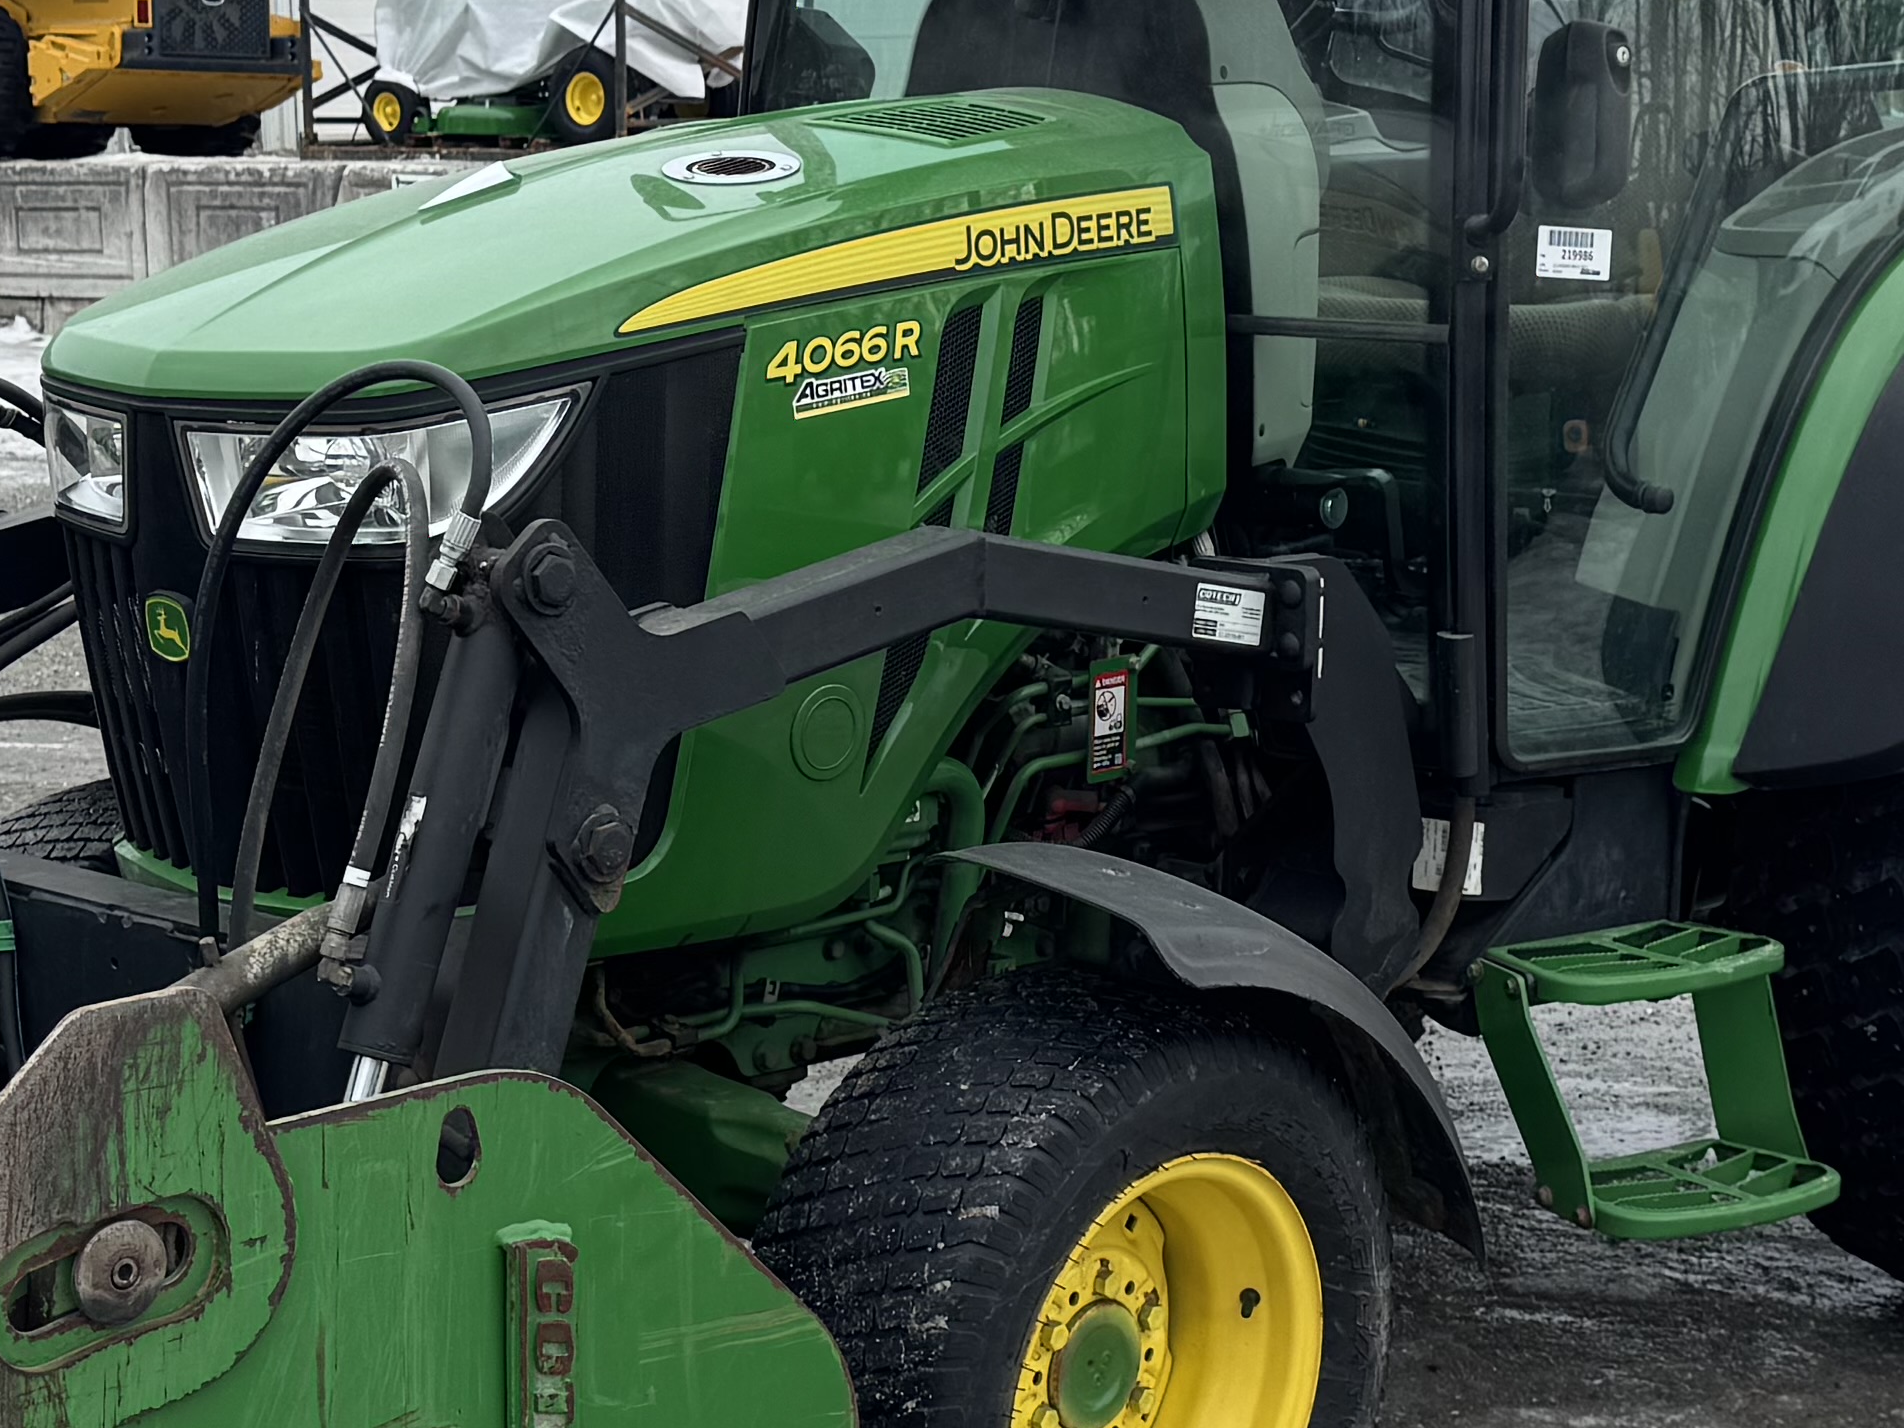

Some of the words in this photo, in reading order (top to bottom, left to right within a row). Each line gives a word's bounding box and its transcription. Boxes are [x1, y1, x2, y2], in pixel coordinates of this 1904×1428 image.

[955, 221, 1045, 266] JOHN
[1051, 207, 1153, 251] DEERE
[796, 370, 885, 404] AGRITEX
